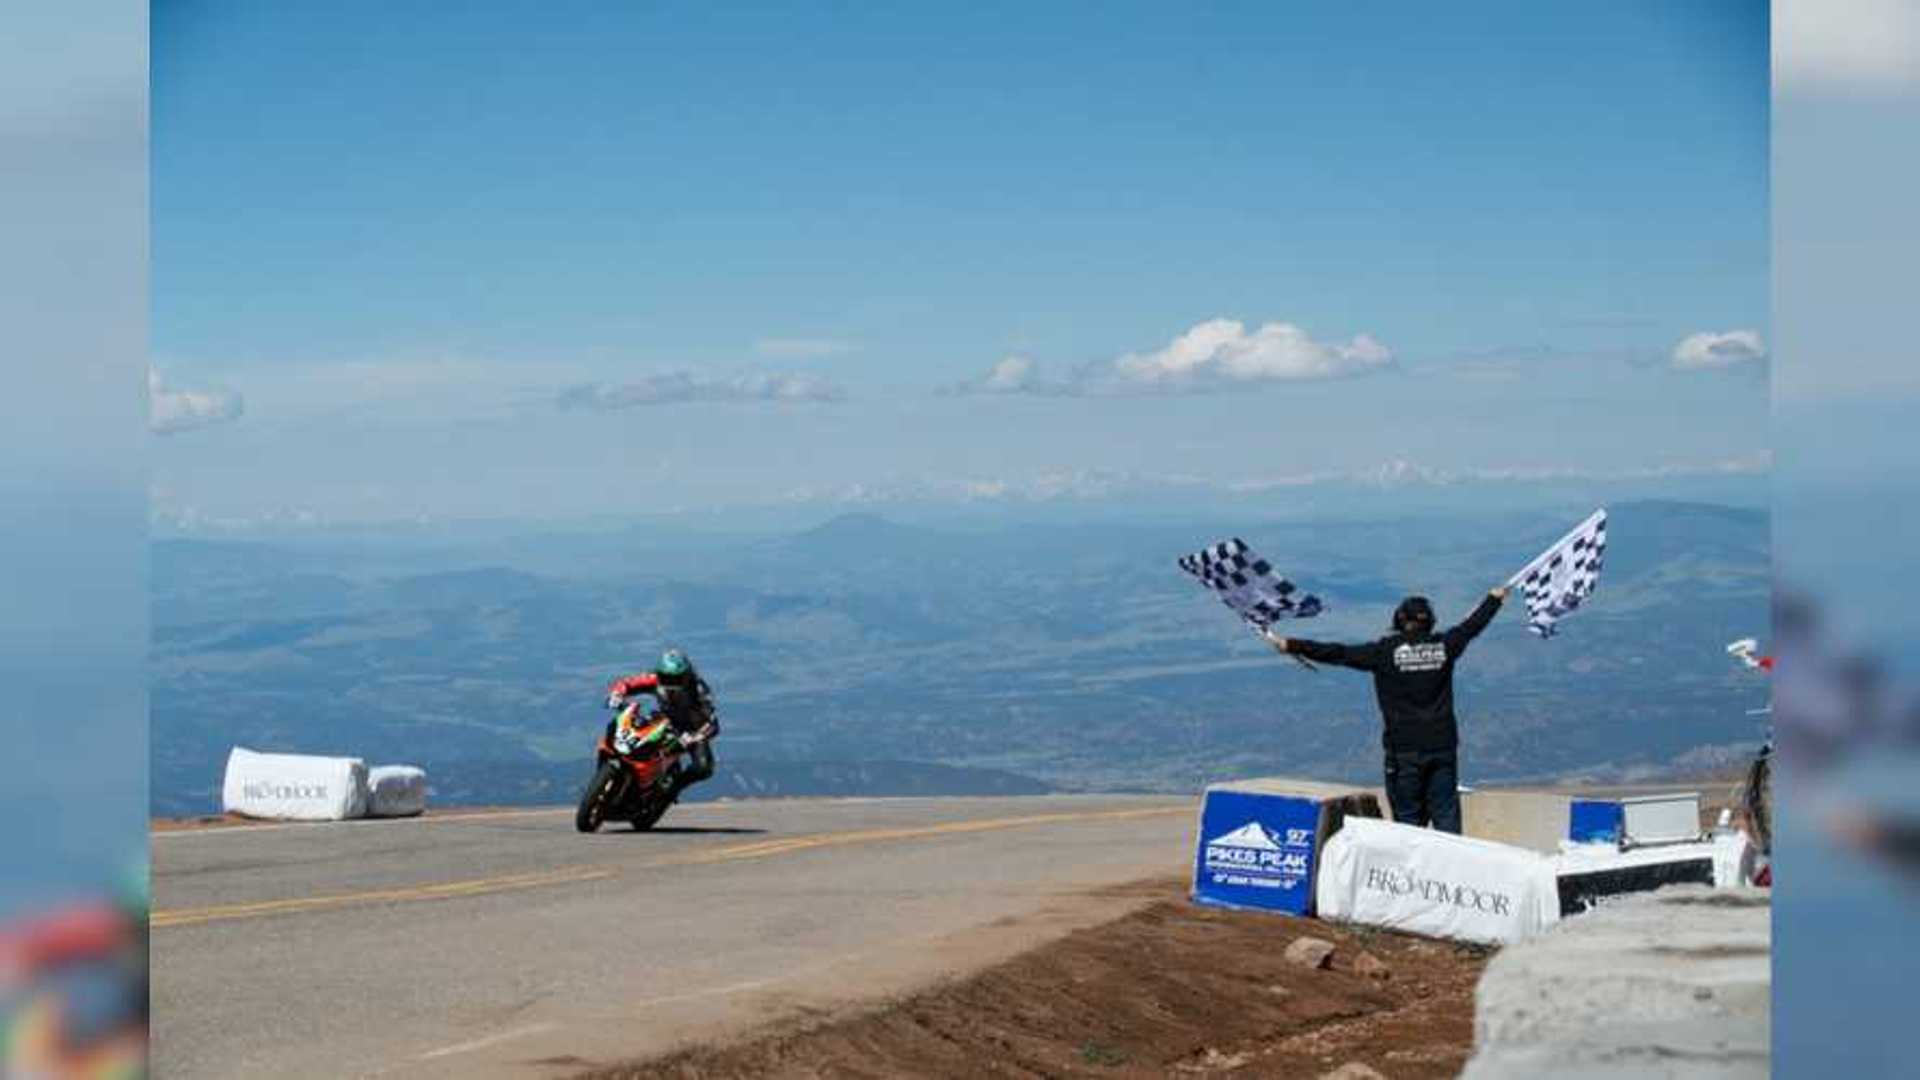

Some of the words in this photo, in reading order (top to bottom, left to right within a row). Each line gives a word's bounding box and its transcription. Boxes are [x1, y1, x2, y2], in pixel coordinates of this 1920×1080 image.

[1206, 847, 1258, 863] PIKES
[1260, 851, 1309, 868] PEAK
[1367, 866, 1510, 917] BROADMOOR
